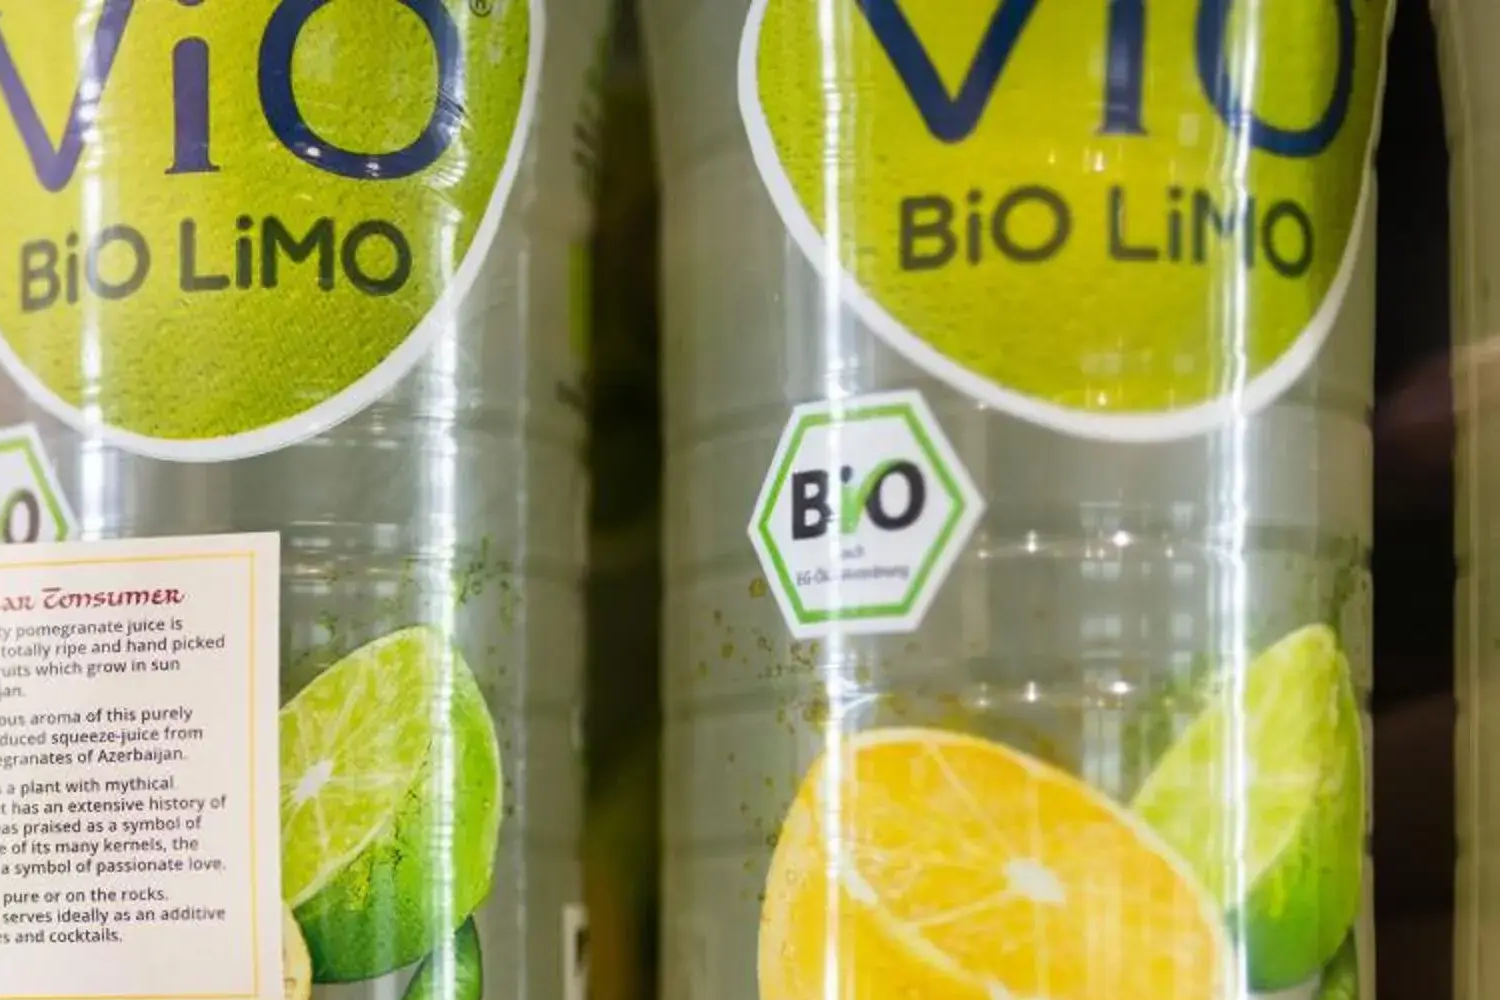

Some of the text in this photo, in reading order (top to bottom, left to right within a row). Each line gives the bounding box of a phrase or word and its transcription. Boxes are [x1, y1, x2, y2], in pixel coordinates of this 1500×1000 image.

[900, 184, 1314, 278] BiO LiMO
[19, 214, 413, 312] BiO LiMO
[792, 458, 926, 541] BiO
[16, 619, 123, 639] pomegranate
[126, 616, 166, 636] juice
[170, 615, 183, 631] is
[1, 642, 50, 659] totally
[55, 640, 86, 657] ripe
[91, 639, 121, 654] and
[126, 637, 167, 653] hand
[172, 634, 226, 655] picked
[35, 661, 82, 677] which
[86, 661, 127, 678] grow
[131, 659, 147, 672] in
[151, 659, 180, 672] sun
[29, 712, 81, 725] aroma
[86, 708, 103, 722] of
[107, 707, 136, 722] this
[141, 705, 194, 724] purely
[51, 727, 160, 747] squeeze-juice
[164, 726, 203, 741] from
[77, 749, 95, 764] of
[97, 747, 188, 765] Azerbaijan.
[7, 783, 16, 795] a
[20, 779, 61, 798] plant
[65, 778, 101, 793] with
[105, 775, 174, 795] mythical
[12, 800, 39, 815] has
[43, 801, 63, 814] an
[67, 798, 145, 813] extensive
[149, 795, 205, 814] history
[210, 793, 227, 809] of
[23, 820, 81, 838] praised
[86, 820, 104, 833] as
[108, 821, 117, 833] a
[122, 816, 180, 835] symbol
[185, 813, 202, 829] of
[11, 839, 28, 855] of
[31, 839, 51, 855] its
[55, 841, 100, 857] many
[103, 837, 167, 854] kernels,
[172, 836, 199, 851] the
[1, 864, 10, 876] a
[14, 860, 71, 879] symbol
[75, 858, 92, 874] of
[96, 856, 184, 876] passionate
[189, 856, 227, 872] love.
[3, 891, 40, 908] pure
[43, 890, 61, 903] or
[65, 889, 85, 902] on
[90, 887, 117, 902] the
[121, 886, 169, 902] rocks.
[2, 911, 53, 924] serves
[57, 907, 109, 926] ideally
[113, 909, 131, 922] as
[135, 908, 155, 922] an
[160, 905, 226, 921] additive
[14, 929, 45, 944] and
[49, 927, 123, 944] cocktails.
